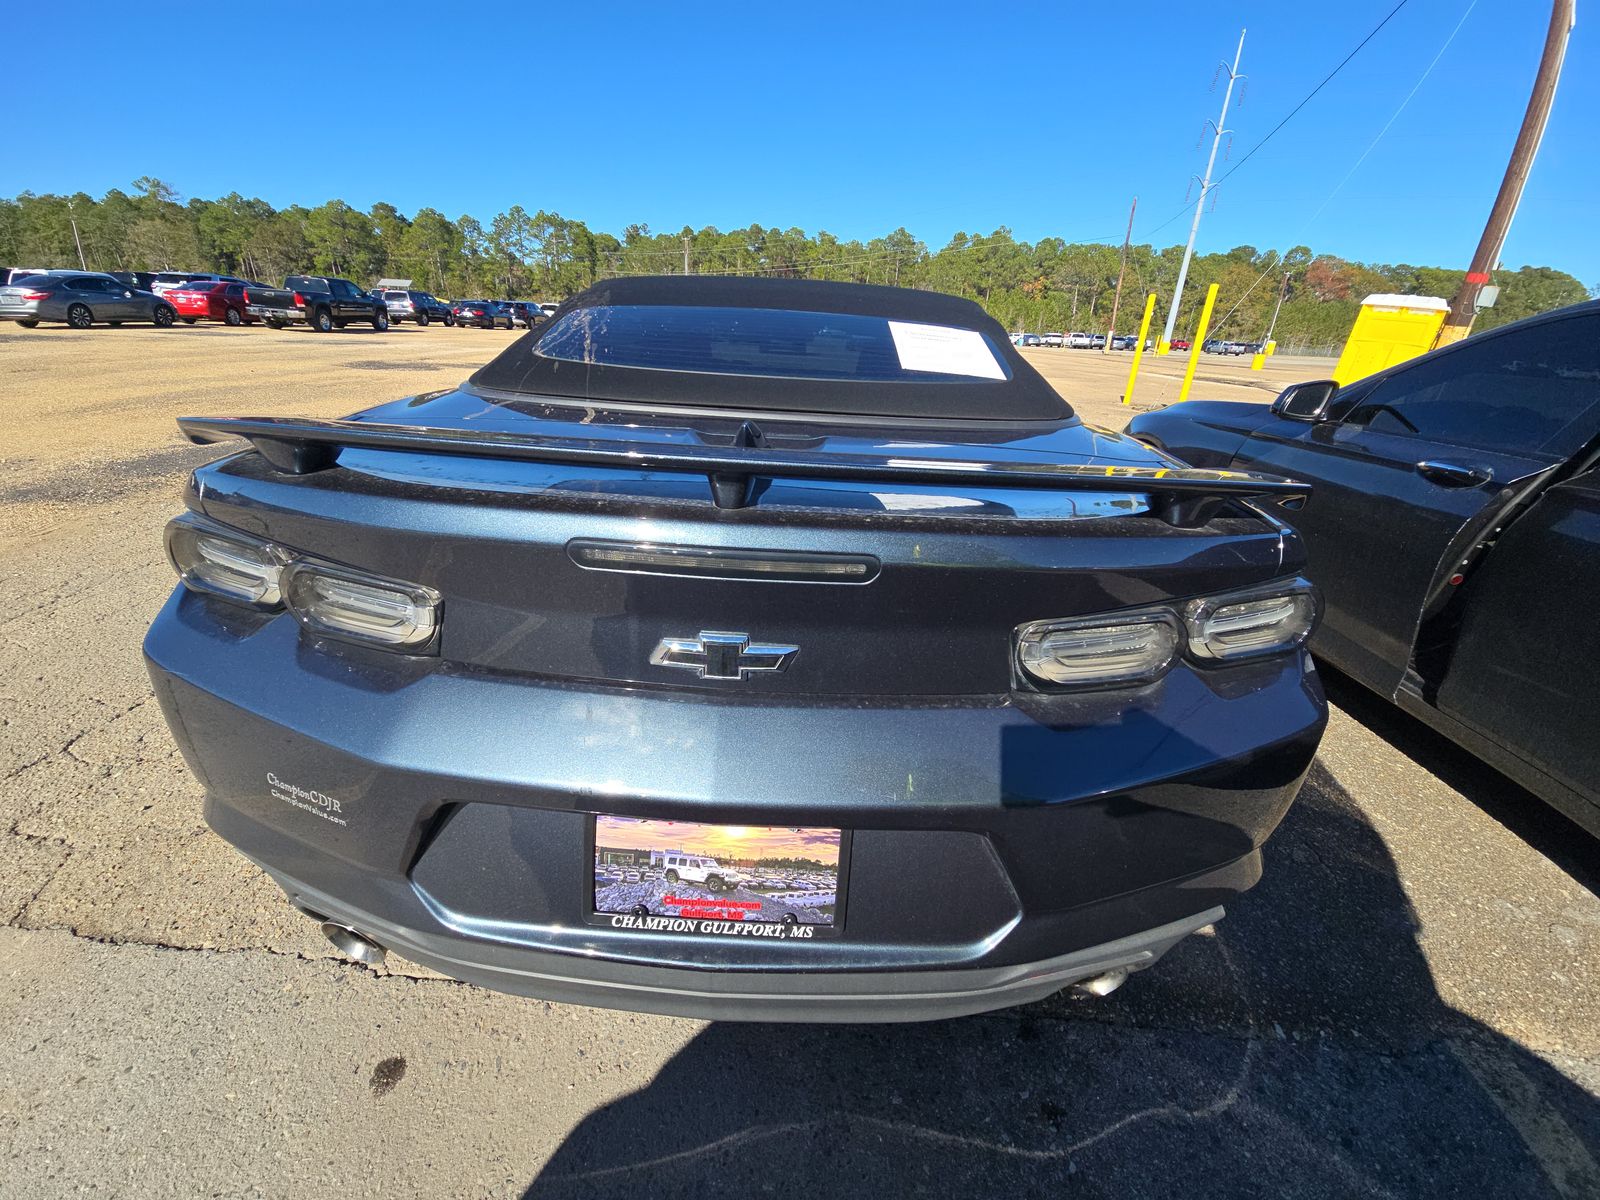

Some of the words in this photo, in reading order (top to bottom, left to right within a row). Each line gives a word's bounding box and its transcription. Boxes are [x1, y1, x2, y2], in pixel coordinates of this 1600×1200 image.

[266, 772, 342, 813] ChampionCDJR
[611, 915, 696, 933] CHAMPION
[700, 919, 786, 939] GULFPORT,
[790, 925, 814, 938] MS
[727, 911, 744, 920] MS
